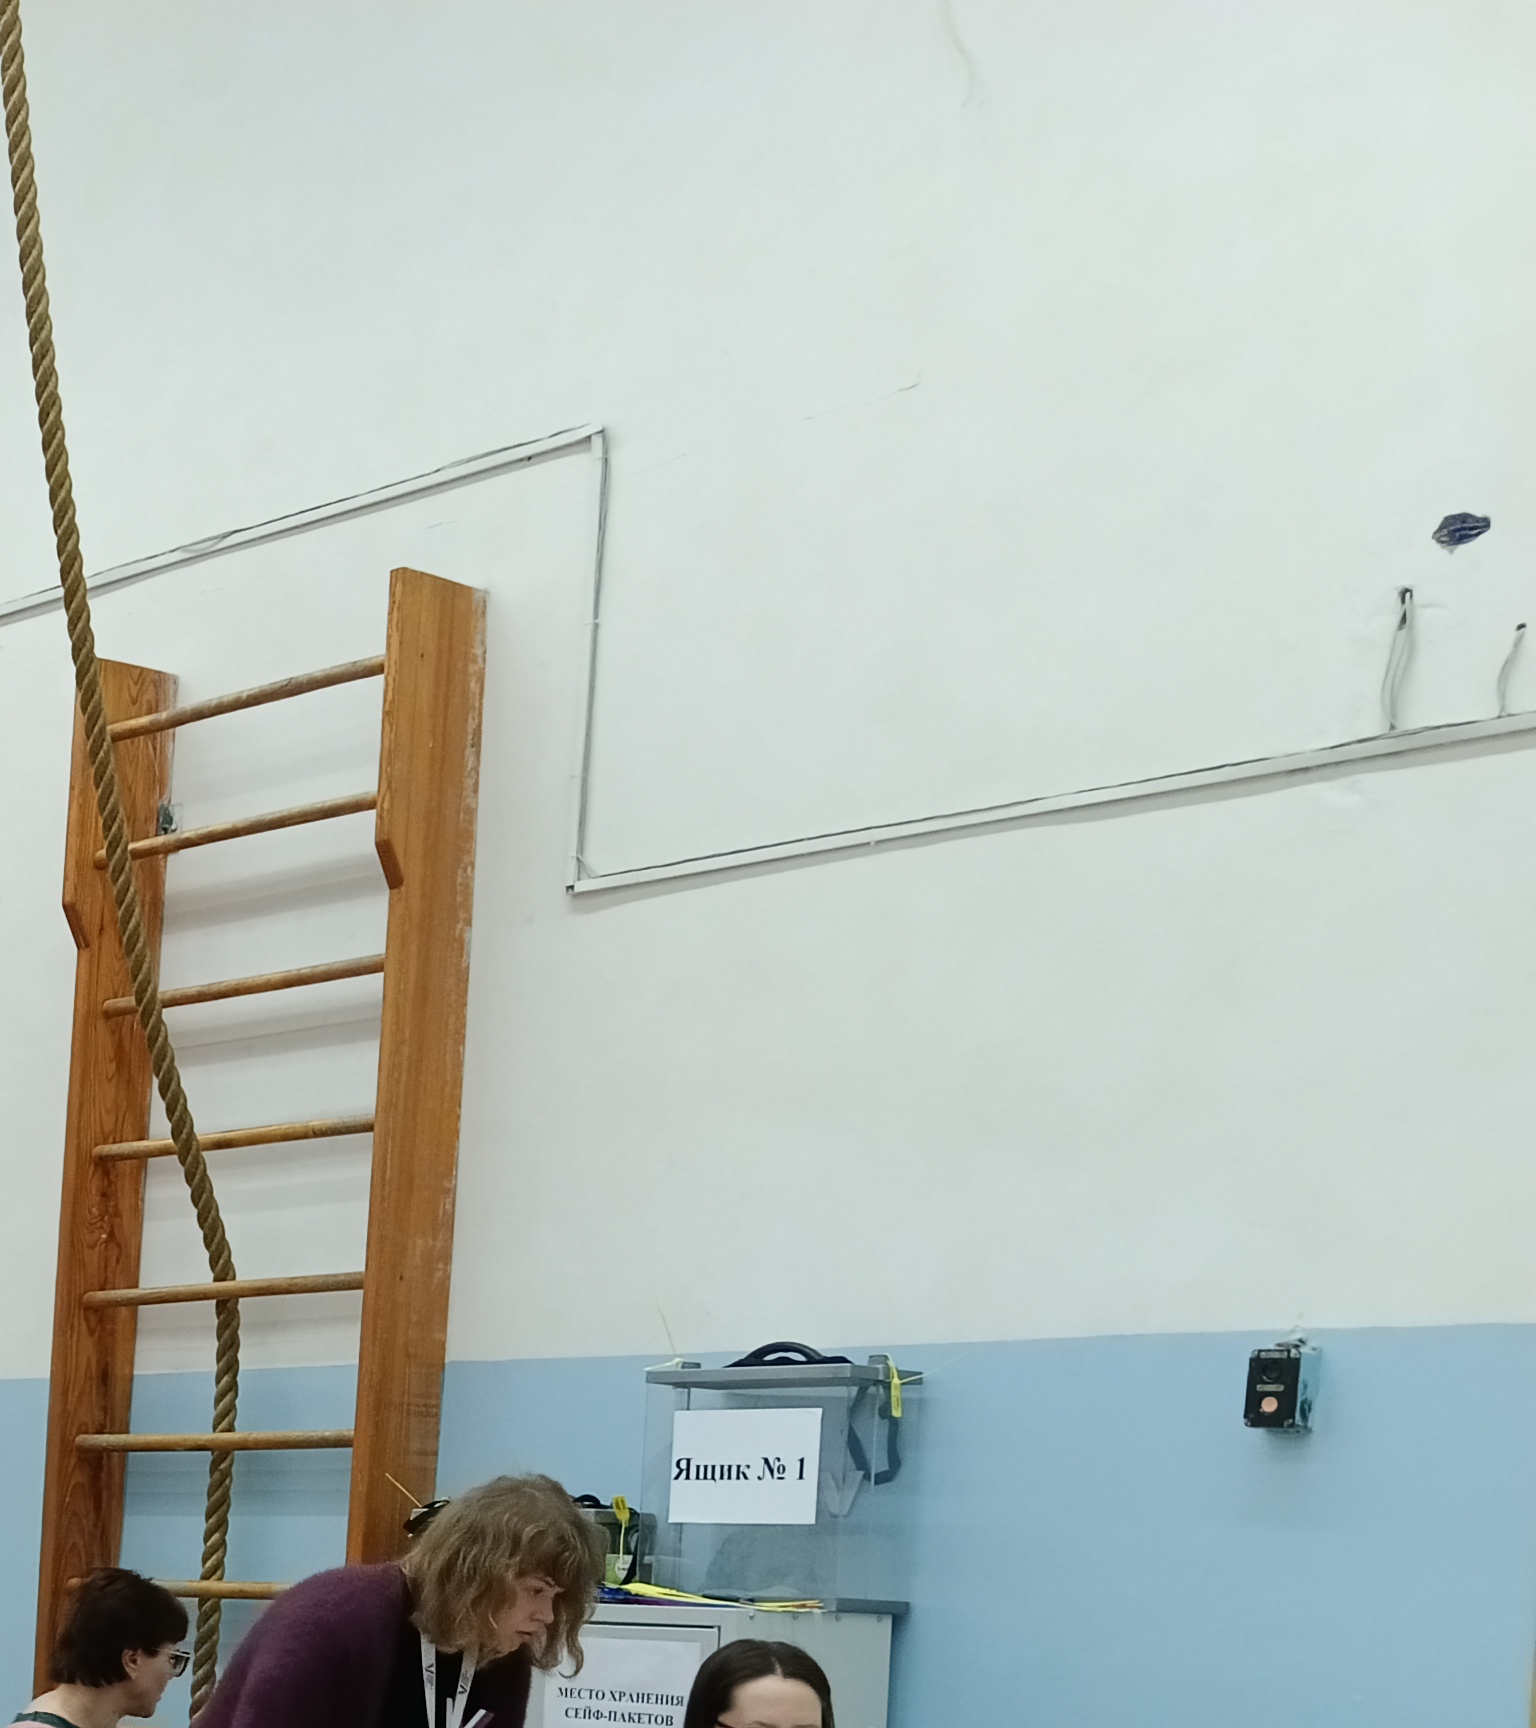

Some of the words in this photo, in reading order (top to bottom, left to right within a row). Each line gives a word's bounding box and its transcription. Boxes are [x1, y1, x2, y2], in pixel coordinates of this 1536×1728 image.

[672, 1456, 751, 1484] Ящик
[756, 1456, 787, 1481] №
[795, 1456, 807, 1481] 1
[556, 1686, 606, 1702] МЕСТО
[608, 1689, 685, 1708] ХРАНЕНИЯ
[564, 1705, 675, 1728] СЕЙФ-ПАКЕТОВ
